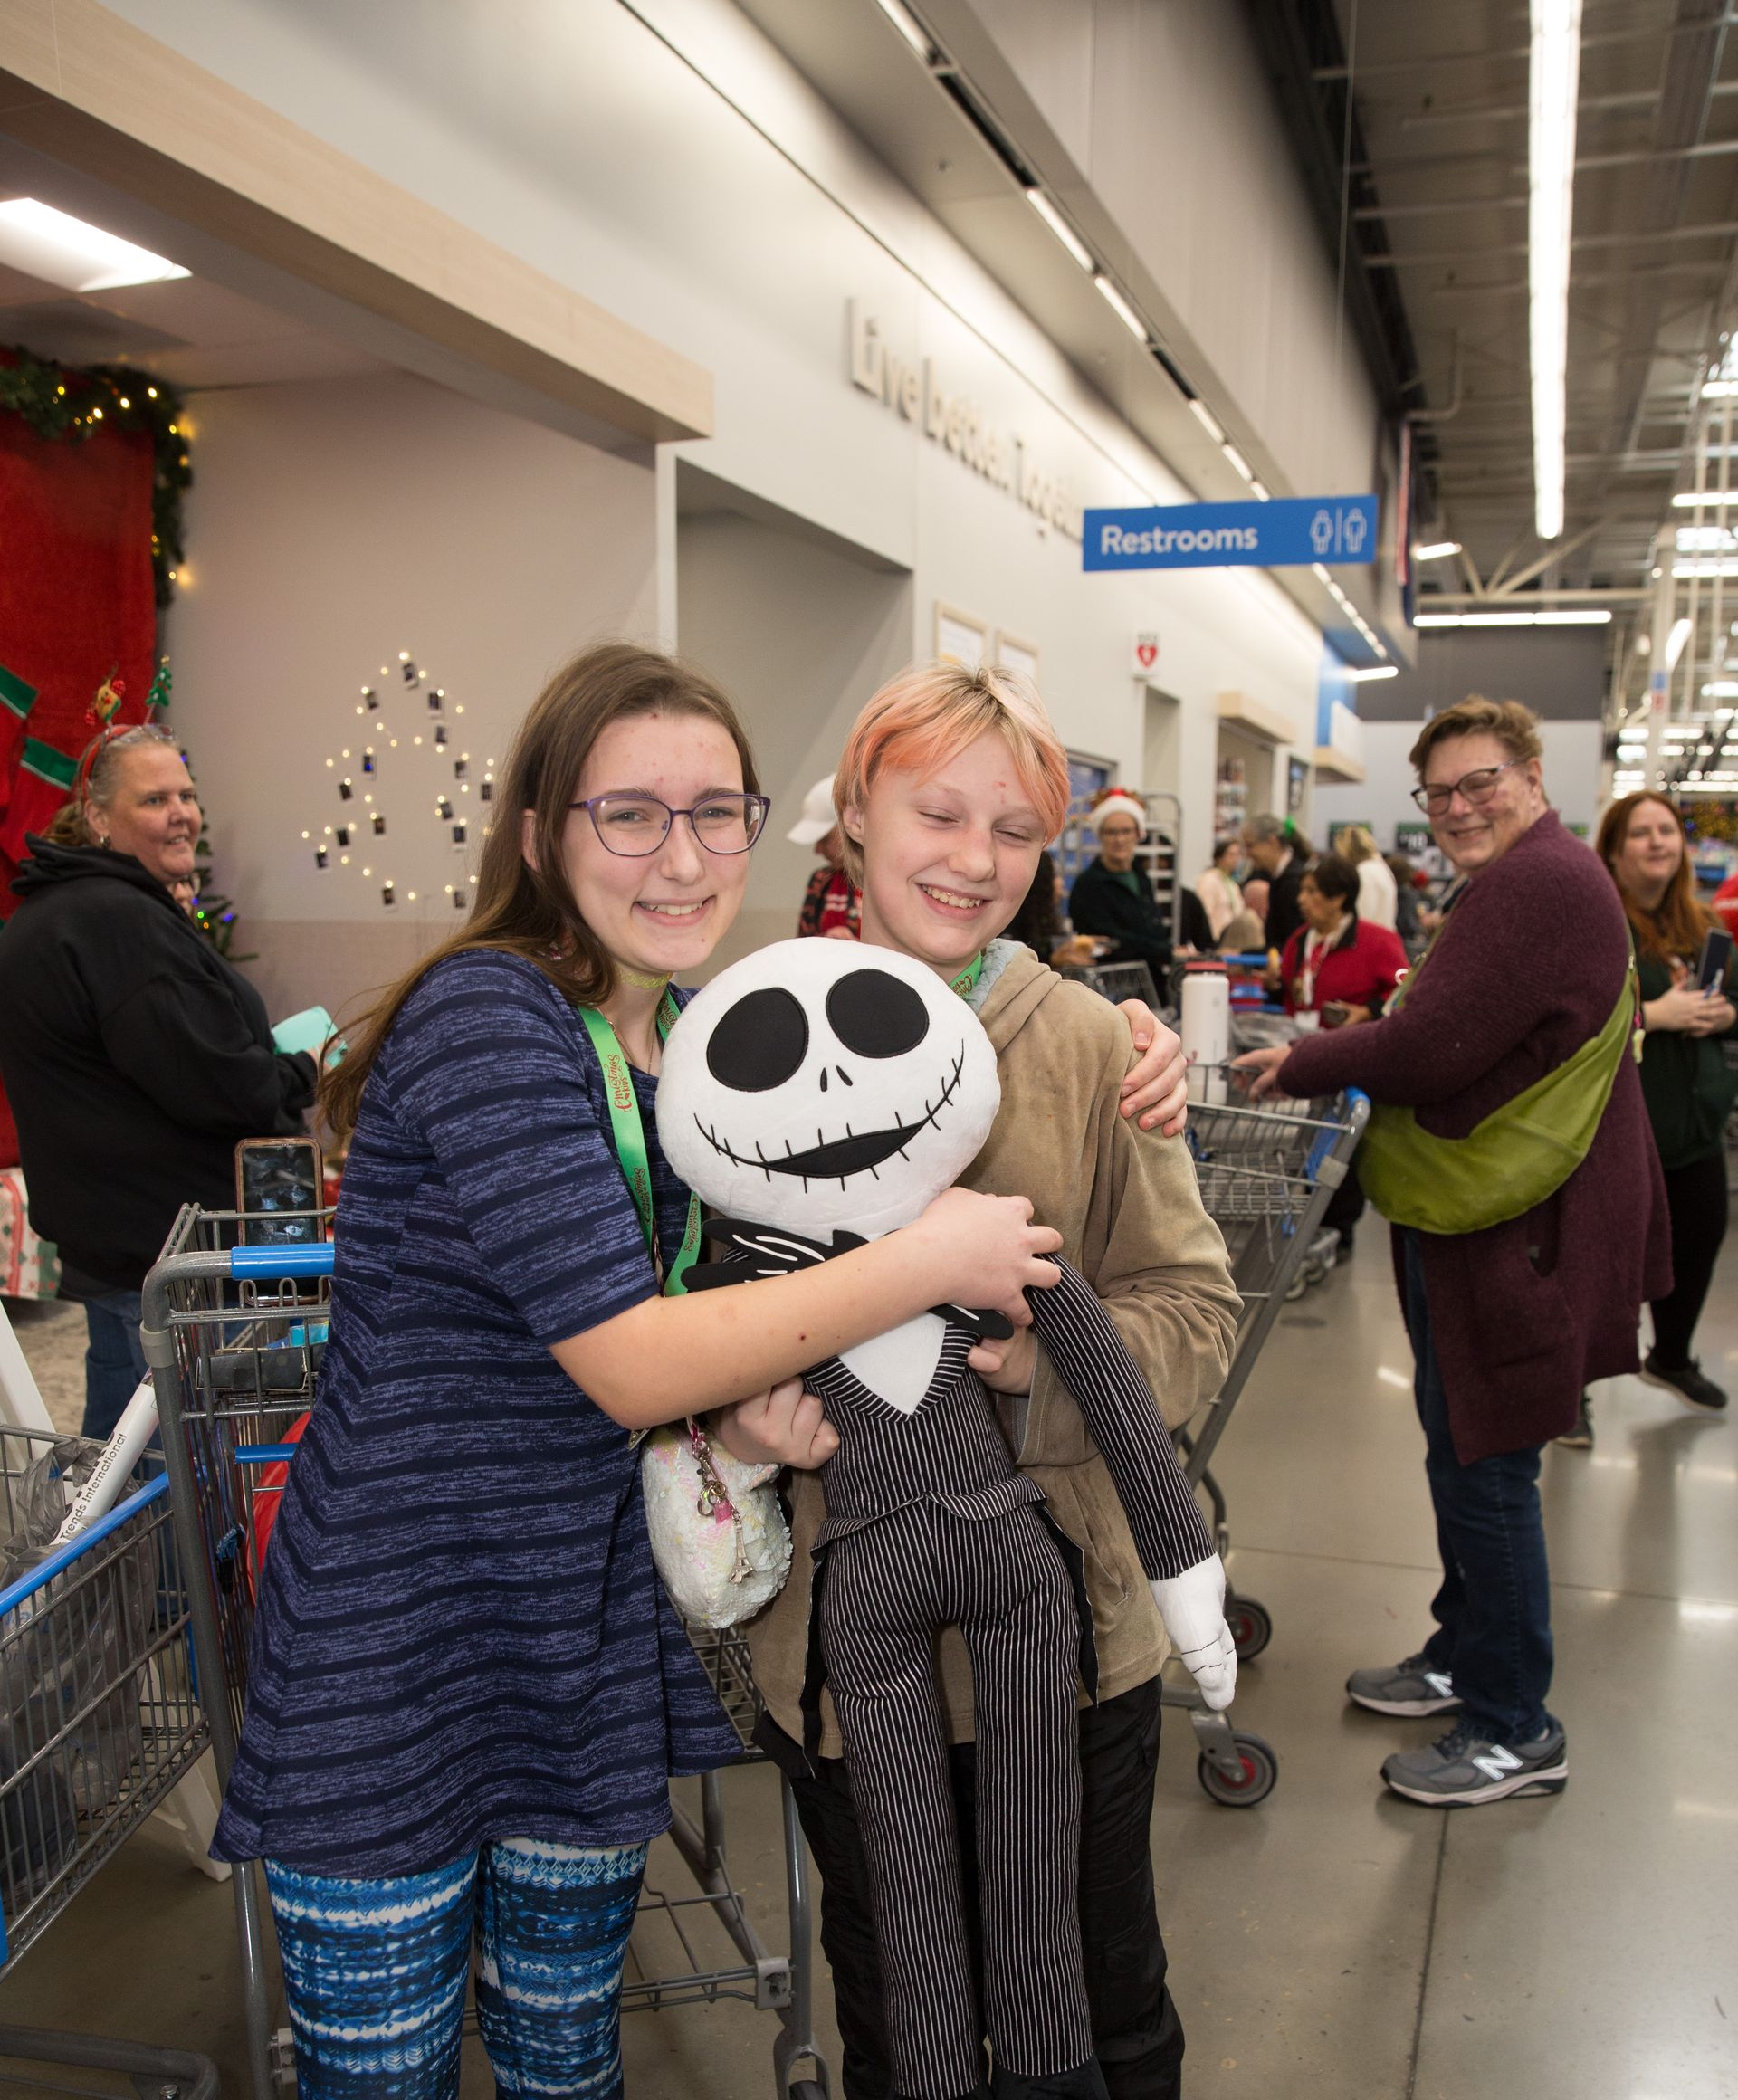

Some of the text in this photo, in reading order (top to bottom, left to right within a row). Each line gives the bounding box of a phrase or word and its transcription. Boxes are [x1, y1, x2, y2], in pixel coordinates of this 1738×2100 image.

[845, 296, 922, 424] Live
[1101, 524, 1259, 556] Restrooms
[604, 1054, 633, 1113] Christmas
[60, 1504, 88, 1540] Trends
[82, 1433, 128, 1503] International
